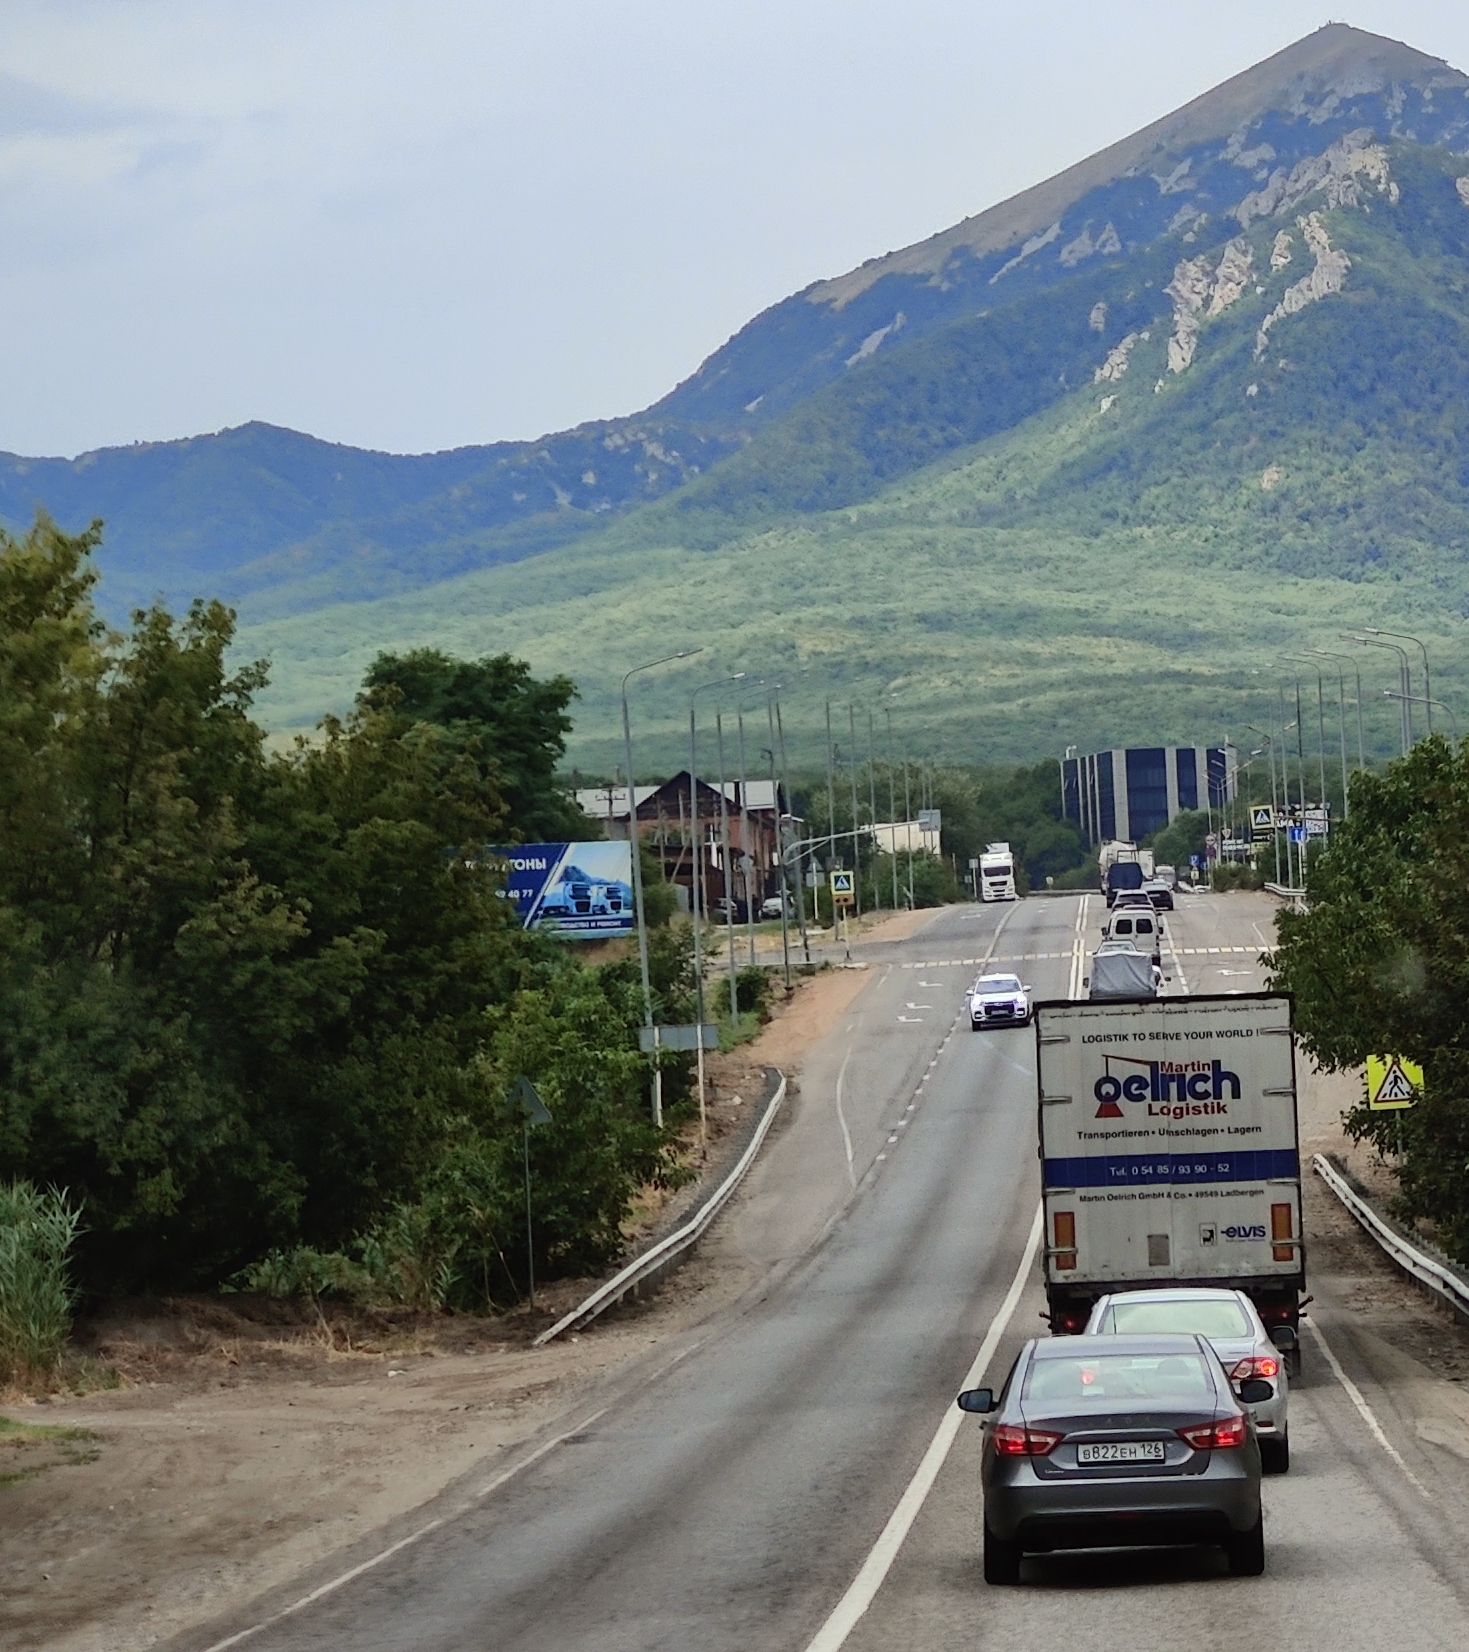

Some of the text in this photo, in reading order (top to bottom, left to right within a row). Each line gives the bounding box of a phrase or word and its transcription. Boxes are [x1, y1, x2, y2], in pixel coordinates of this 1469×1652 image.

[522, 889, 533, 898] 77
[1082, 1033, 1129, 1043] LOGISTIK
[1132, 1032, 1146, 1041] TO
[1148, 1032, 1182, 1041] SERVE
[1185, 1031, 1213, 1040] YOUR
[1215, 1029, 1253, 1038] WORLD
[1160, 1061, 1211, 1073] Martin
[1148, 1102, 1228, 1119] Logistik
[1077, 1126, 1262, 1141] Transportieren Umschlagen Lagern
[1141, 1166, 1153, 1175] 54
[1157, 1165, 1169, 1174] 85
[1178, 1165, 1191, 1174] 93
[1195, 1164, 1207, 1174] 90
[1217, 1163, 1230, 1173] 52
[1079, 1194, 1106, 1202] Martin
[1107, 1193, 1137, 1201] Oelrich
[1138, 1192, 1164, 1200] GmbH
[1220, 1188, 1265, 1198] Ladbergen
